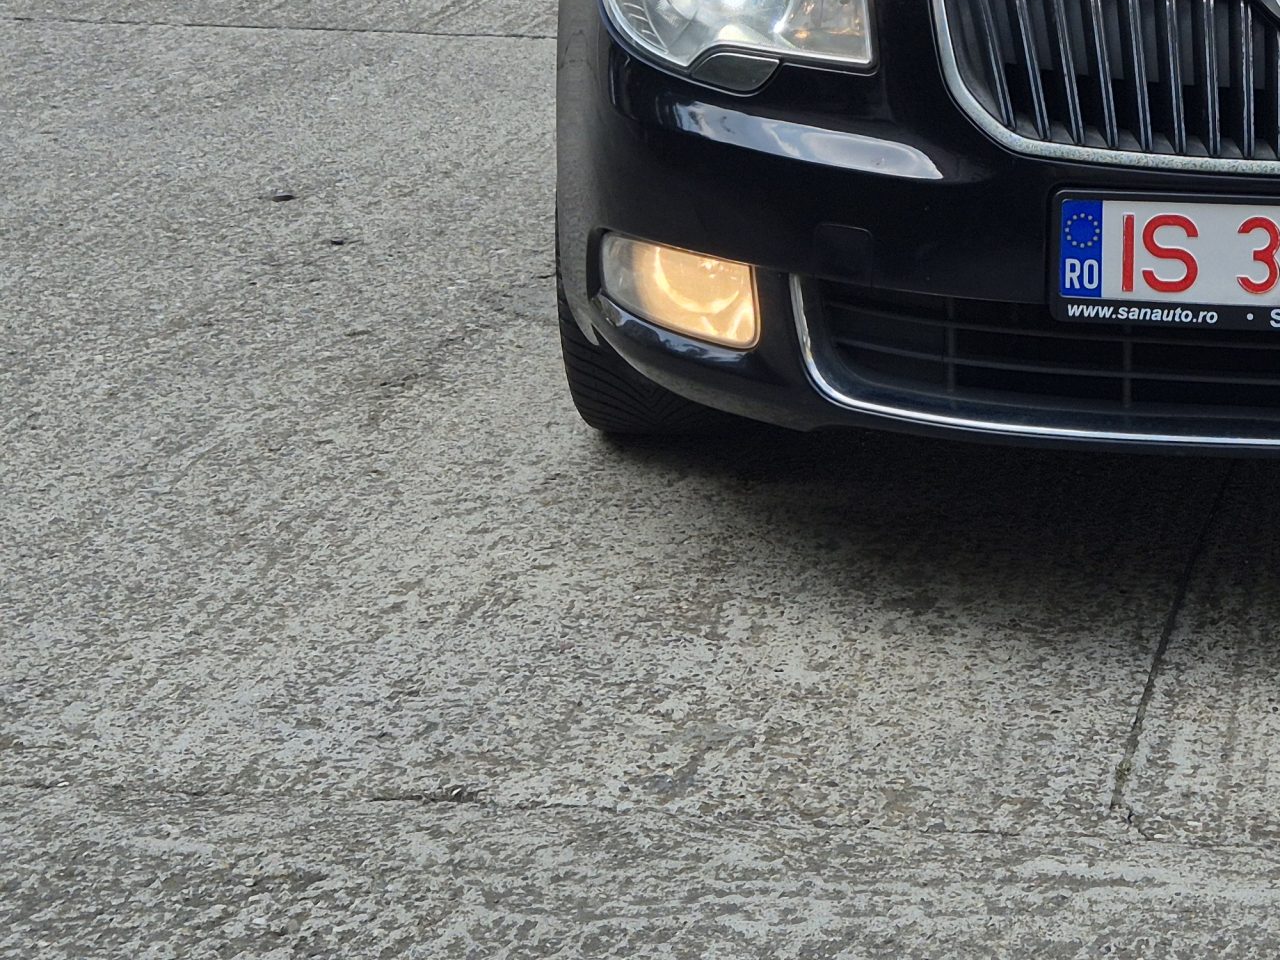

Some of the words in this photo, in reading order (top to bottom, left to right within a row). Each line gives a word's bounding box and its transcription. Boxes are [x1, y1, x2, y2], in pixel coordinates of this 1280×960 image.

[1121, 212, 1200, 294] IS
[1064, 258, 1099, 291] RO
[1067, 303, 1219, 325] www.sanauto.ro
